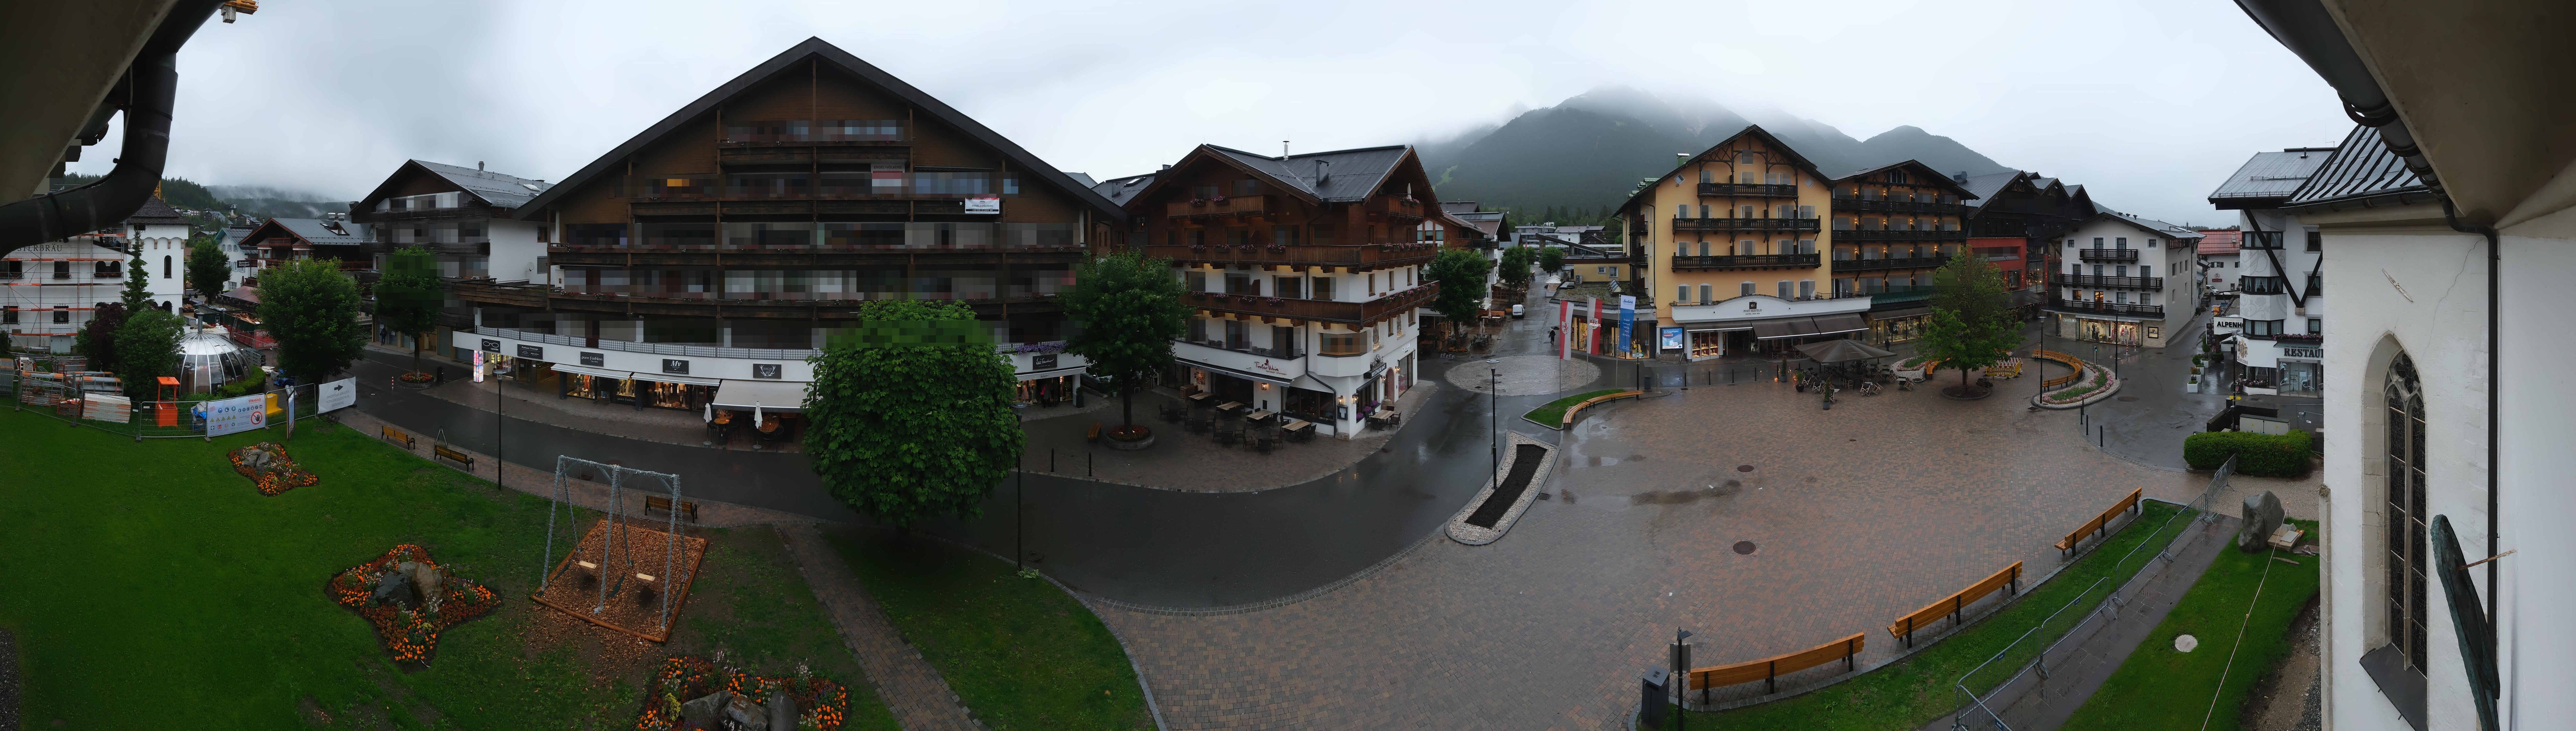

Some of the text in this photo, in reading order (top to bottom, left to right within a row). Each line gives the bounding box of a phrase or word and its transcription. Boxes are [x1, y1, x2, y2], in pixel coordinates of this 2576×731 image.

[670, 360, 681, 370] My
[1372, 364, 1386, 377] RESTAURANT
[326, 395, 349, 404] KONGRESSZENTRUM
